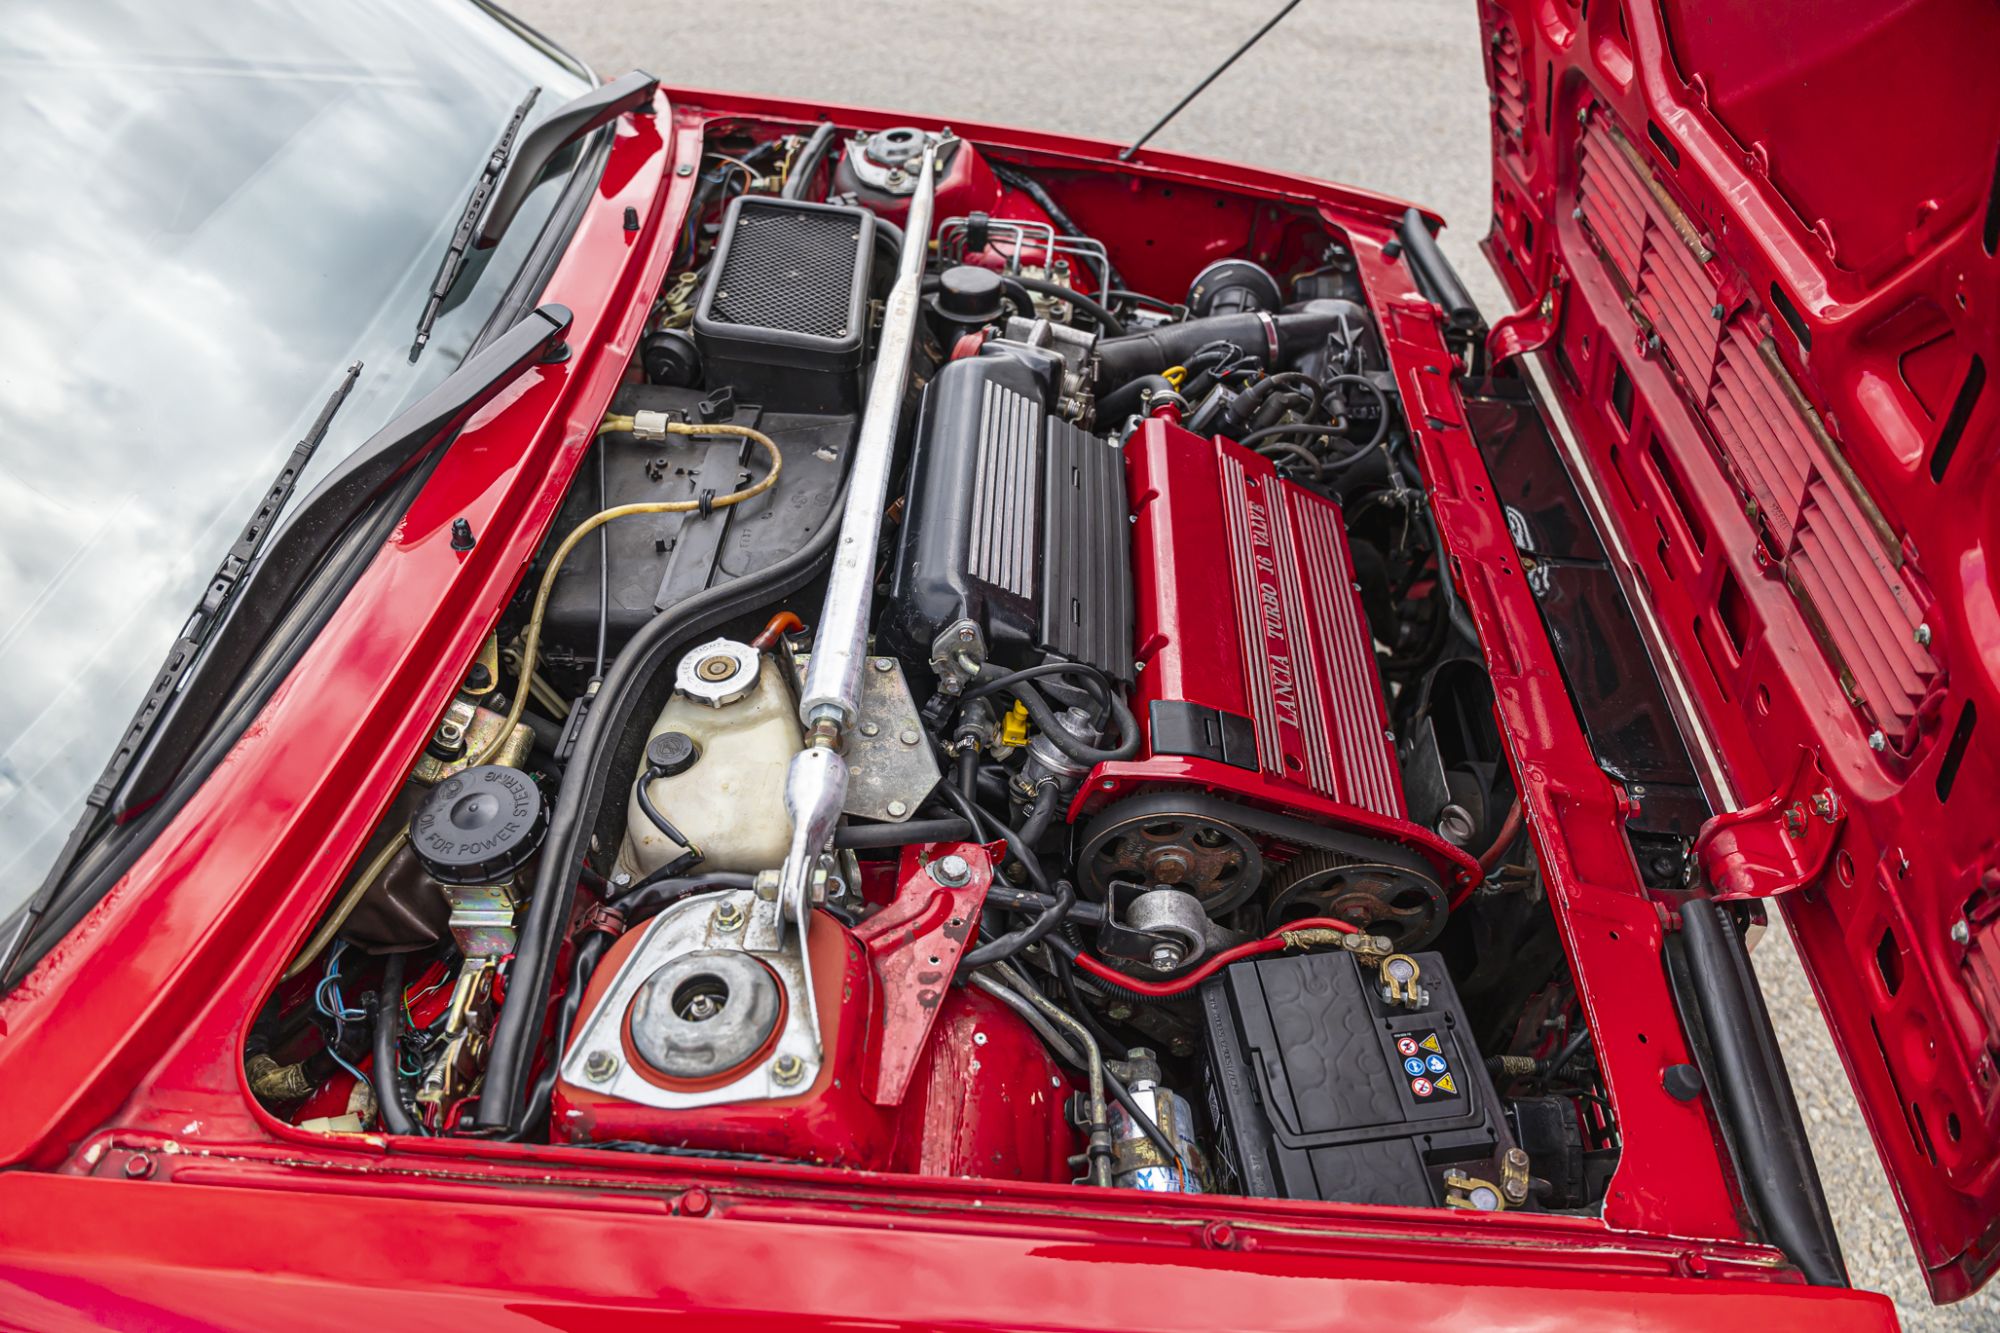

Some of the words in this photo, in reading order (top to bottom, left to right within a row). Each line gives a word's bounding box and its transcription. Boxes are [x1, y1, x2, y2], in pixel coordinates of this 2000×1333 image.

[1249, 501, 1271, 548] VALVE
[1256, 554, 1274, 576] 16
[1260, 582, 1285, 641] TURBO
[1270, 654, 1299, 729] LANCIA
[484, 771, 529, 817] STEERING
[420, 813, 434, 834] OIL
[425, 833, 455, 854] FOR
[457, 821, 522, 856] POWER
